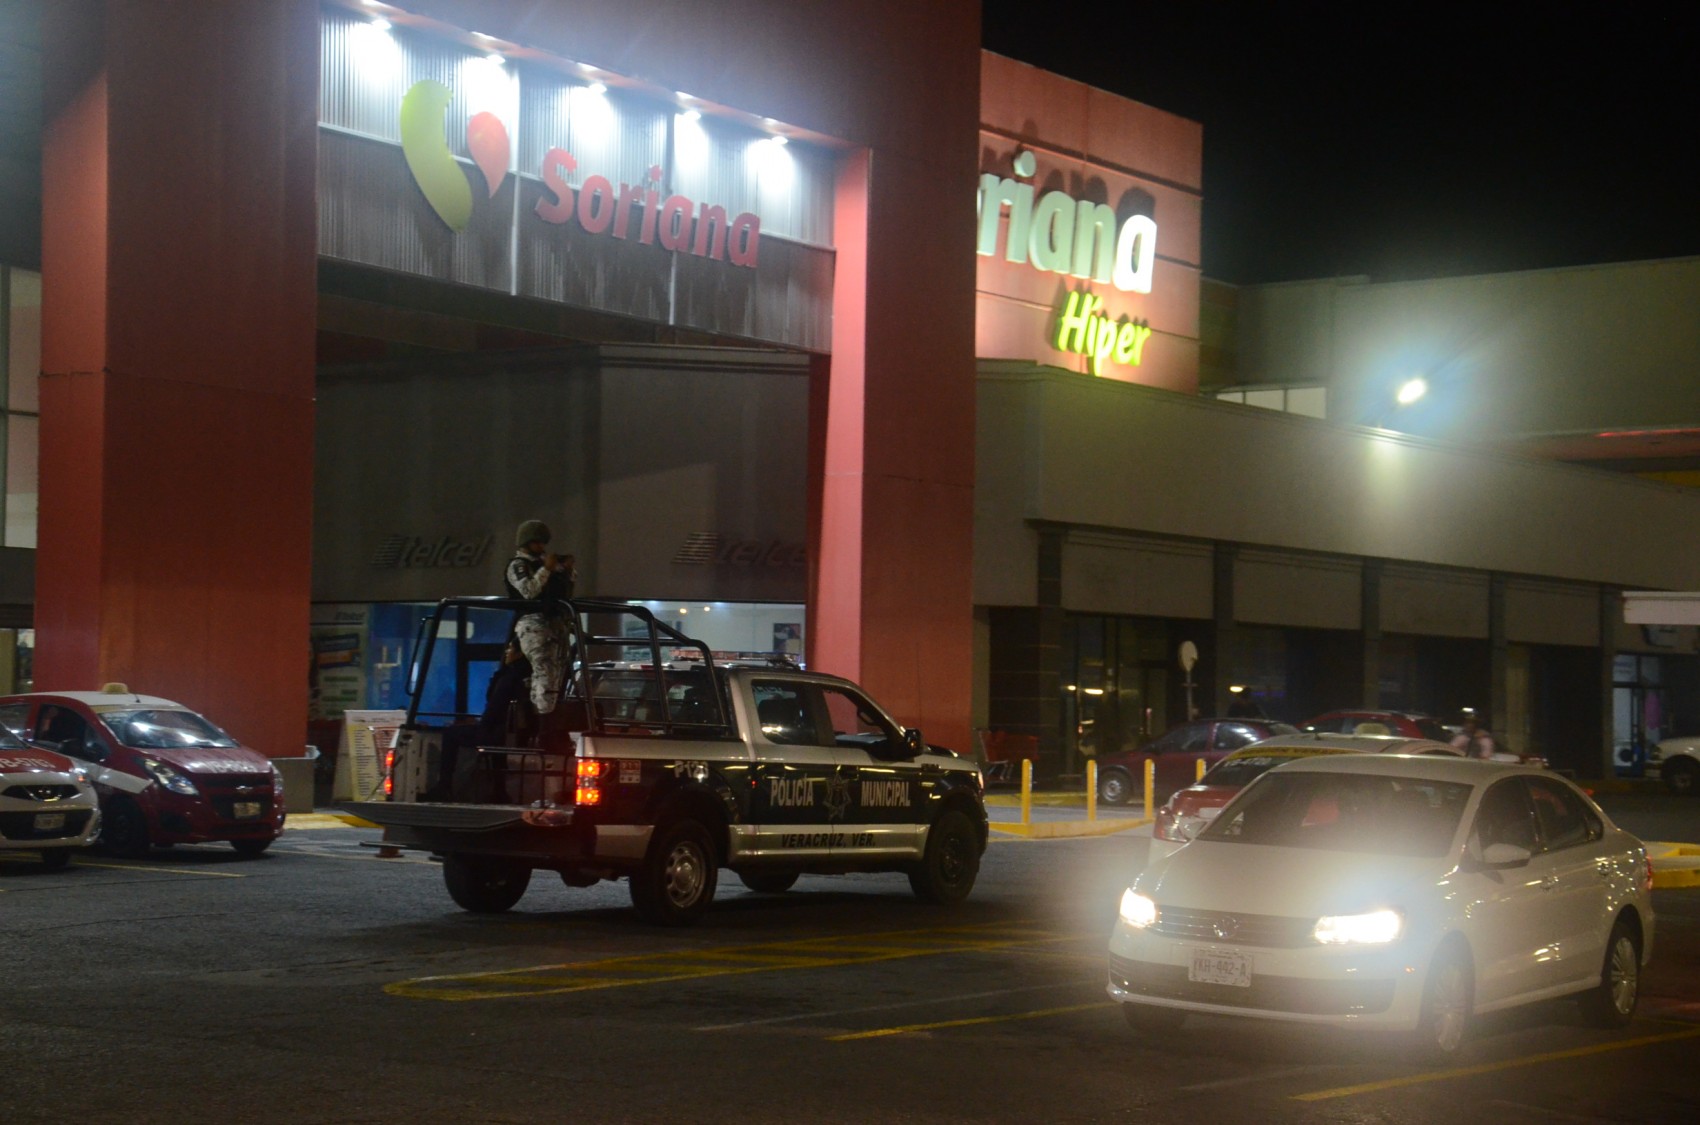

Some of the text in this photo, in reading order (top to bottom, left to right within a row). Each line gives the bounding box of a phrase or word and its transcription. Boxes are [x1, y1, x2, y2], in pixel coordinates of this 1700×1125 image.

[535, 146, 761, 268] Soriana
[976, 150, 1157, 294] riana
[861, 781, 911, 807] MUNICIPAL
[852, 833, 876, 847] VER.
